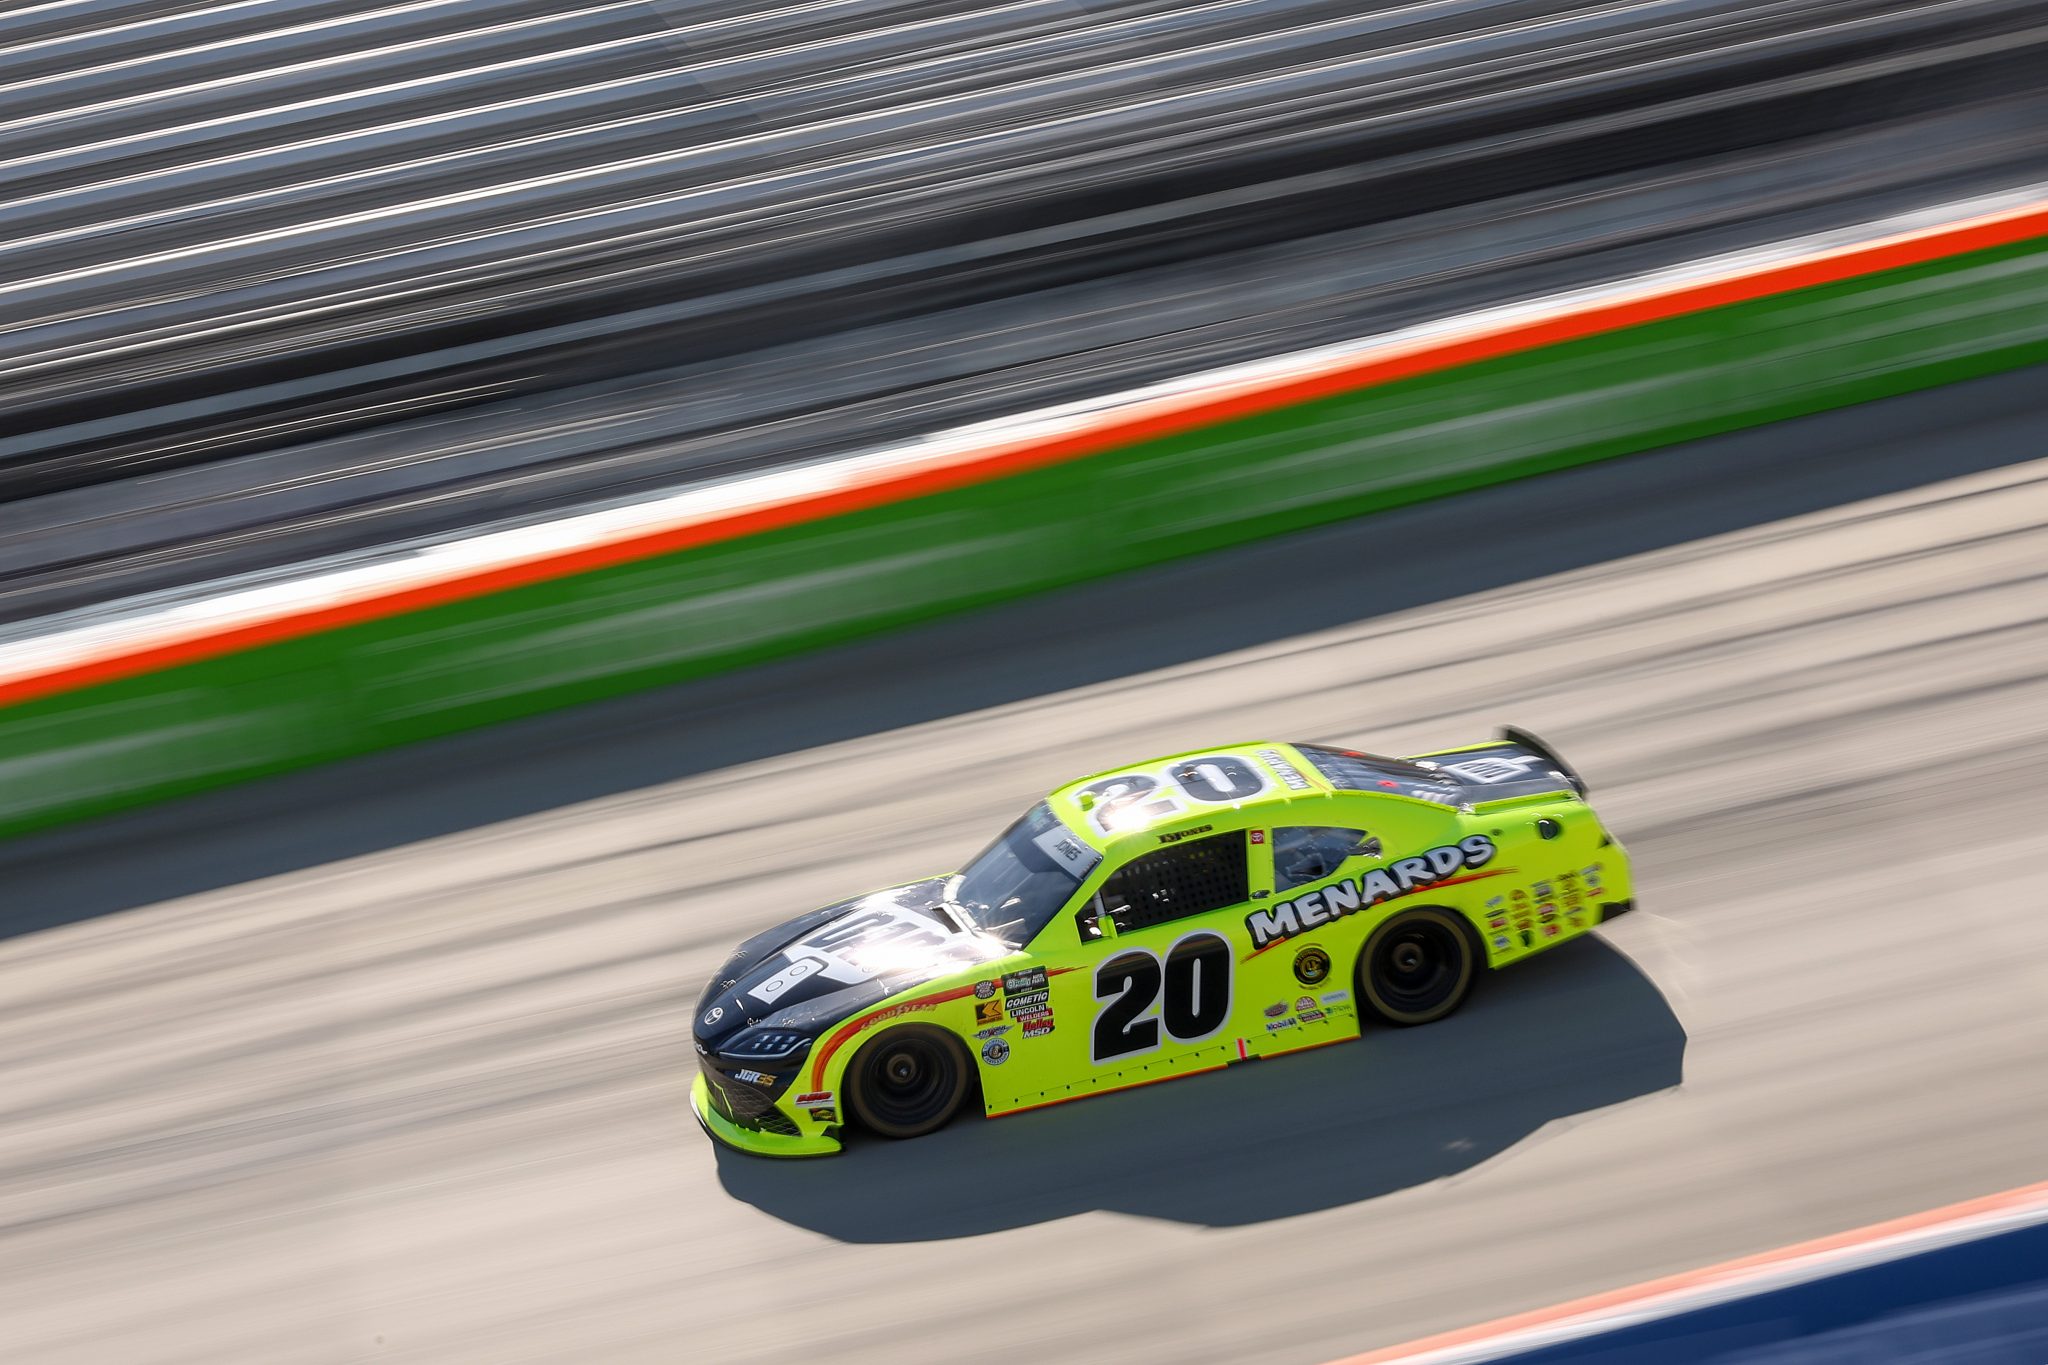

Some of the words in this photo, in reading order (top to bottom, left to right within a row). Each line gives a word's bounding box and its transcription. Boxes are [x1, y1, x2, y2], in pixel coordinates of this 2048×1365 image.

[1247, 834, 1497, 950] MENARDS
[1006, 994, 1048, 1008] COMETIC
[1093, 932, 1231, 1063] 20
[1011, 1004, 1045, 1017] LINCOLN
[1020, 1010, 1050, 1021] WELDERS
[1023, 1028, 1050, 1038] MSD
